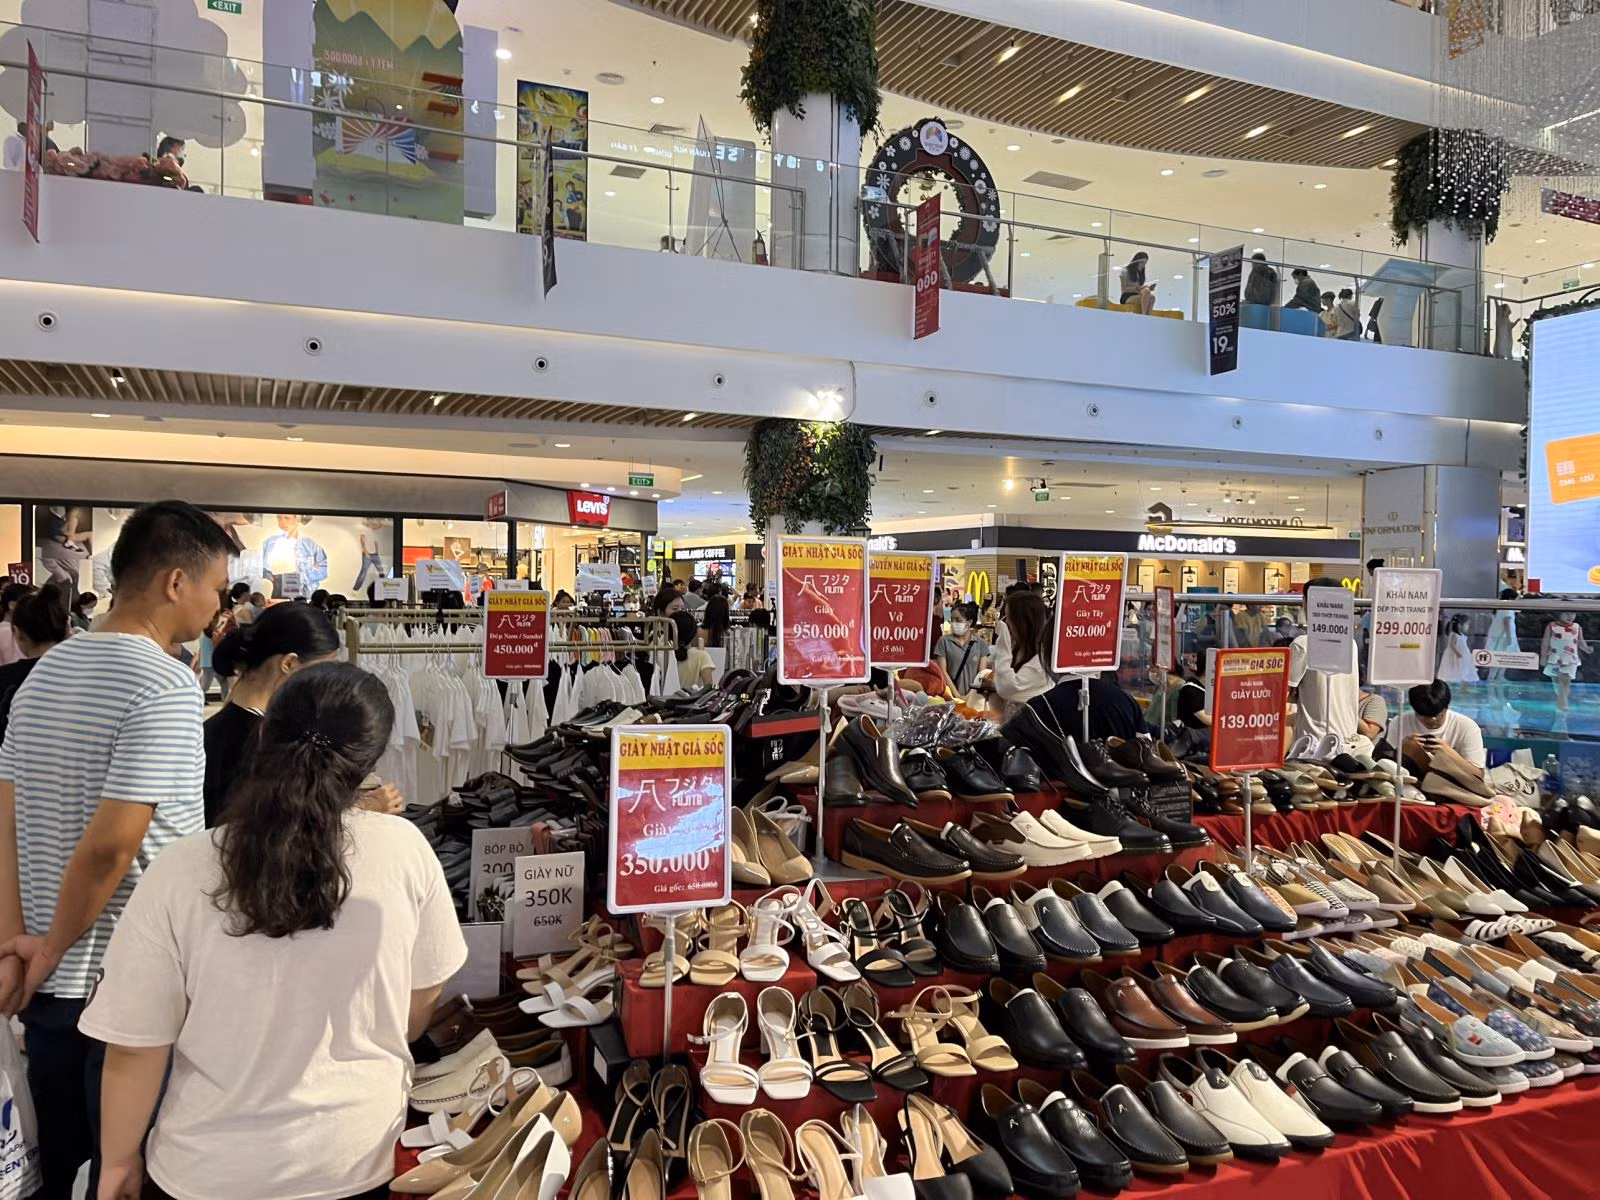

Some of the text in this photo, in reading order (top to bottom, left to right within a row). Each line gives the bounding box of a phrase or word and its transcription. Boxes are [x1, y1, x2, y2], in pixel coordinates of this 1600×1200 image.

[217, 1, 237, 12] EXIT
[1213, 302, 1236, 318] 50%
[632, 477, 646, 486] EXIT
[867, 536, 898, 550] nald's
[1138, 534, 1236, 553] McDonald's
[705, 548, 726, 559] COFFEE
[870, 557, 892, 571] HUYẾN
[820, 574, 850, 586] フジタ
[891, 584, 921, 595] フジタ
[1408, 591, 1428, 600] NAM
[872, 626, 924, 641] 00.000đ
[1312, 623, 1348, 635] 149.000đ
[1375, 621, 1433, 635] 299.000đ
[522, 632, 543, 640] Sandal
[1231, 688, 1251, 700] GIÀY
[1220, 712, 1280, 729] 139.000đ
[620, 734, 724, 760] GIÀY NHẬT GIÁ SỐC
[672, 794, 703, 807] FUJITA
[483, 862, 514, 874] 300
[524, 864, 574, 880] GIÀY NỮ
[654, 883, 668, 893] Giá
[525, 887, 573, 908] 350K
[533, 914, 563, 927] 650K
